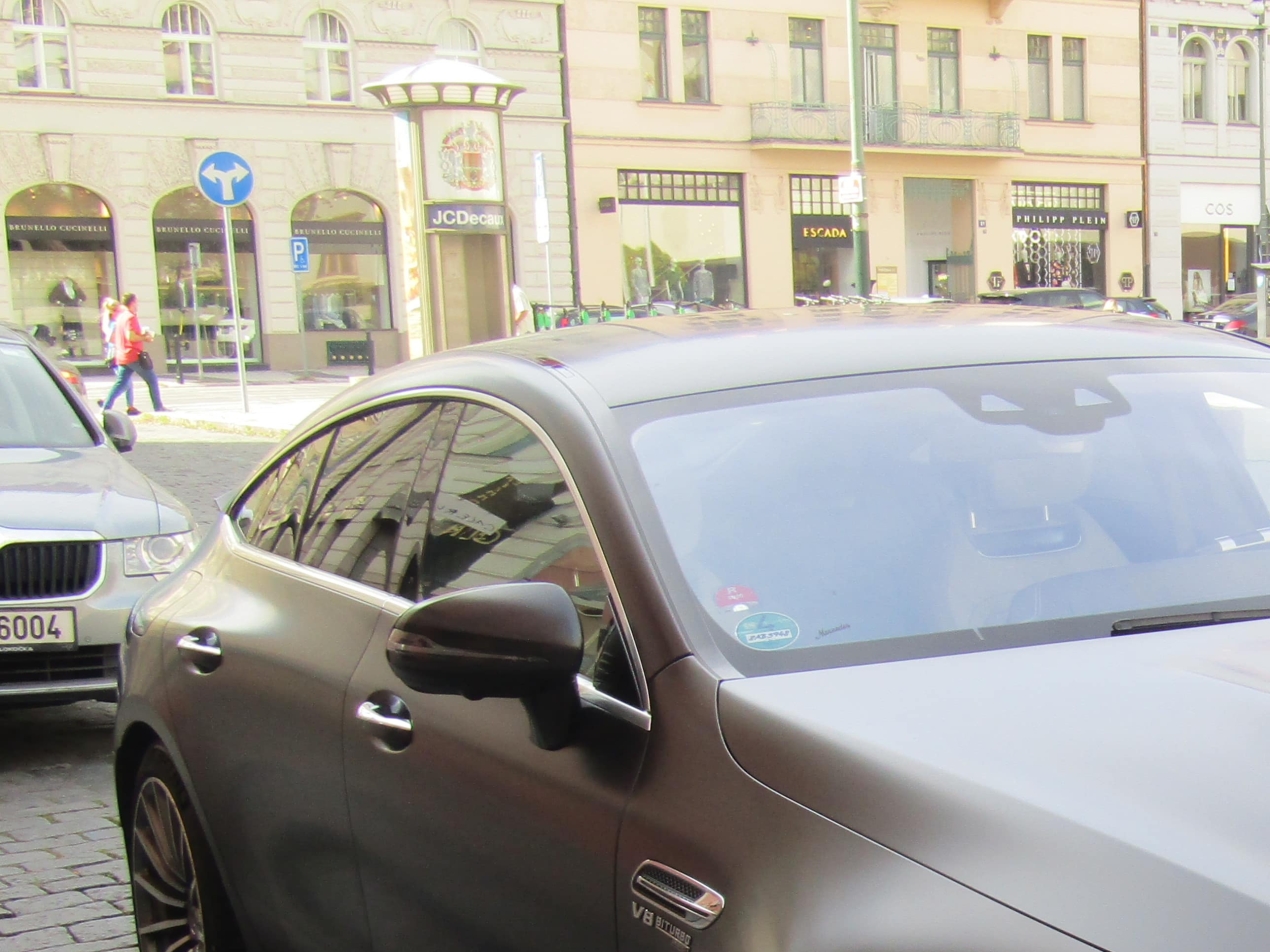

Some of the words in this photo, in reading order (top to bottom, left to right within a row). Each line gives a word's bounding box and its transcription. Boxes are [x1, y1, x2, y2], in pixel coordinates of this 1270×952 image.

[1205, 203, 1234, 216] COS
[1017, 215, 1065, 223] PHILIPP
[1072, 216, 1106, 225] PLEIN
[803, 227, 847, 238] ESCADA
[293, 241, 304, 261] P
[632, 901, 654, 927] V8
[655, 916, 692, 946] BITURBO
